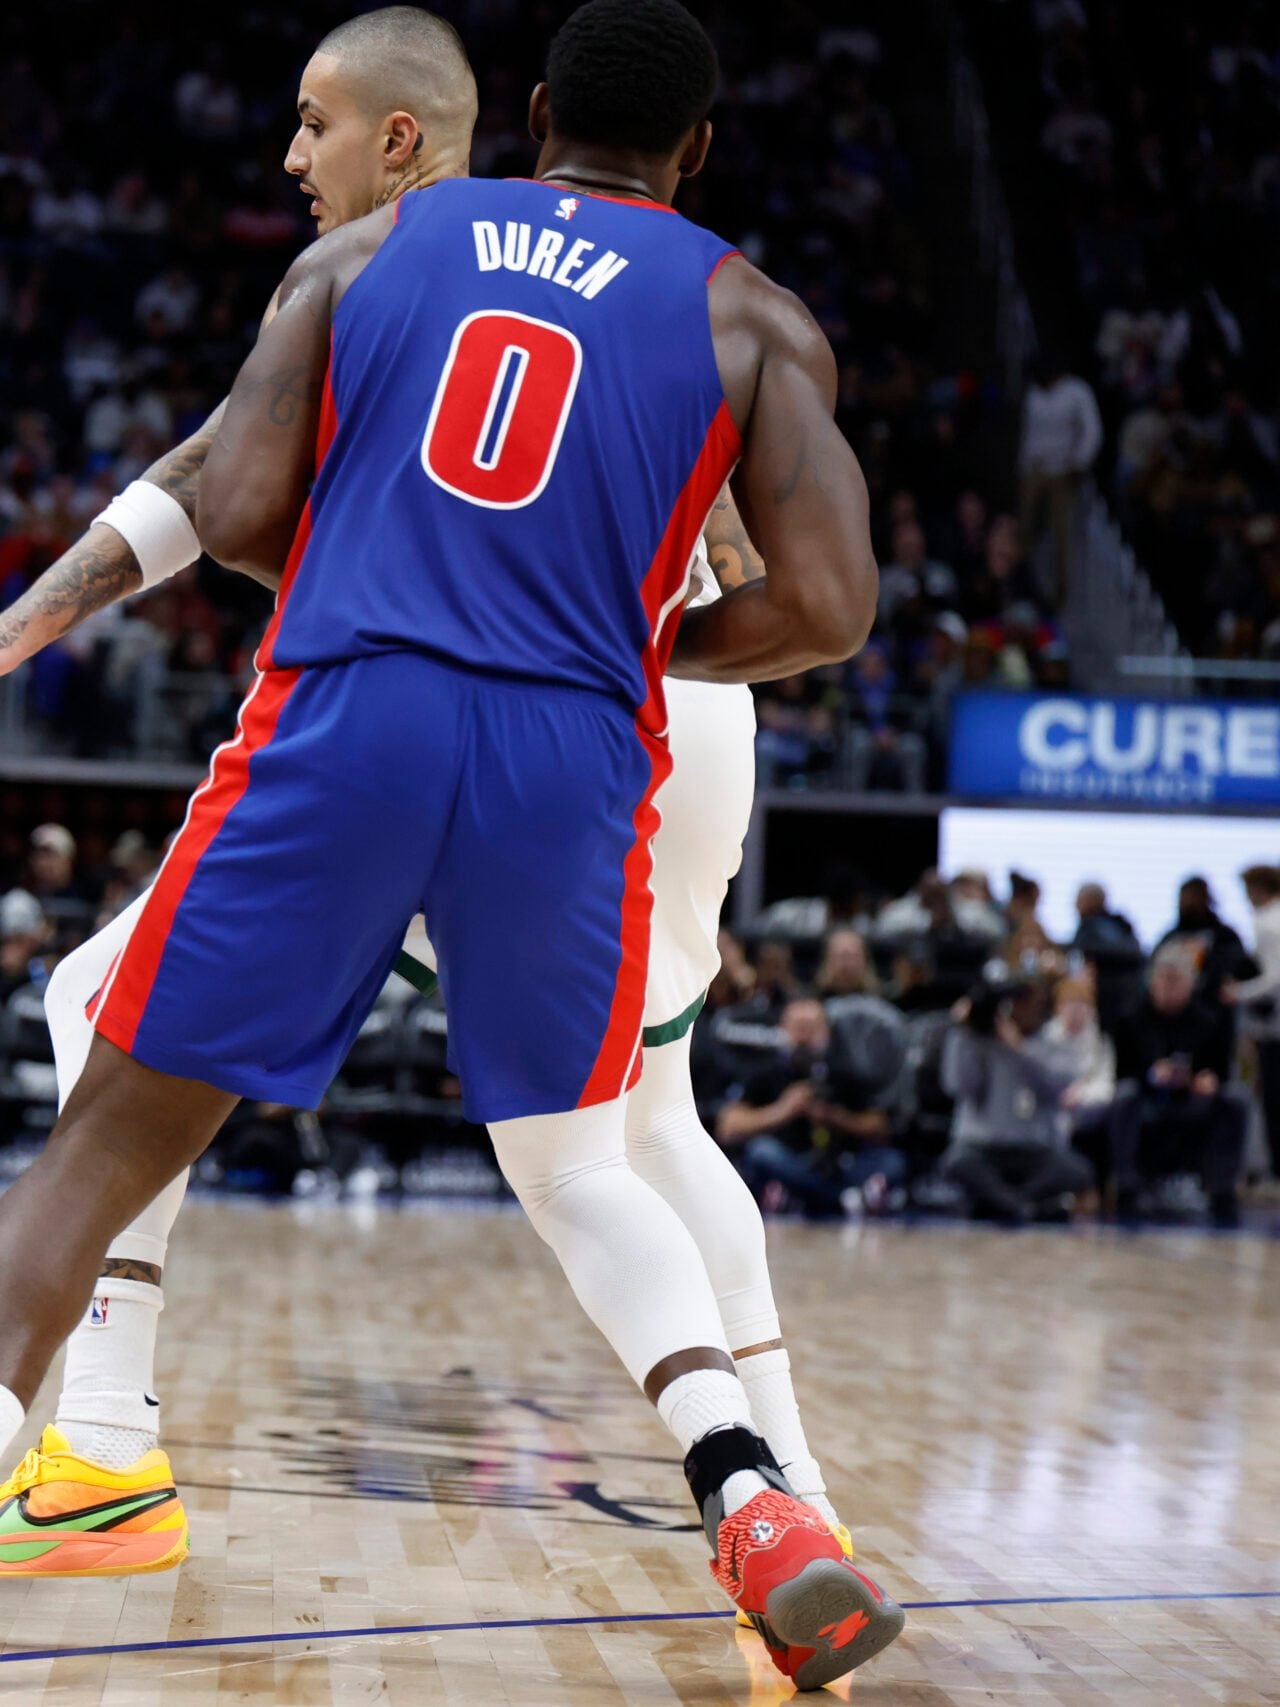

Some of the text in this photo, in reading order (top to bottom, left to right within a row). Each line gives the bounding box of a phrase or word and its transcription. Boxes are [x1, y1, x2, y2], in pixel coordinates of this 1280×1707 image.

[472, 221, 629, 300] DUREN
[421, 309, 583, 510] 0
[1020, 698, 1279, 777] CURE
